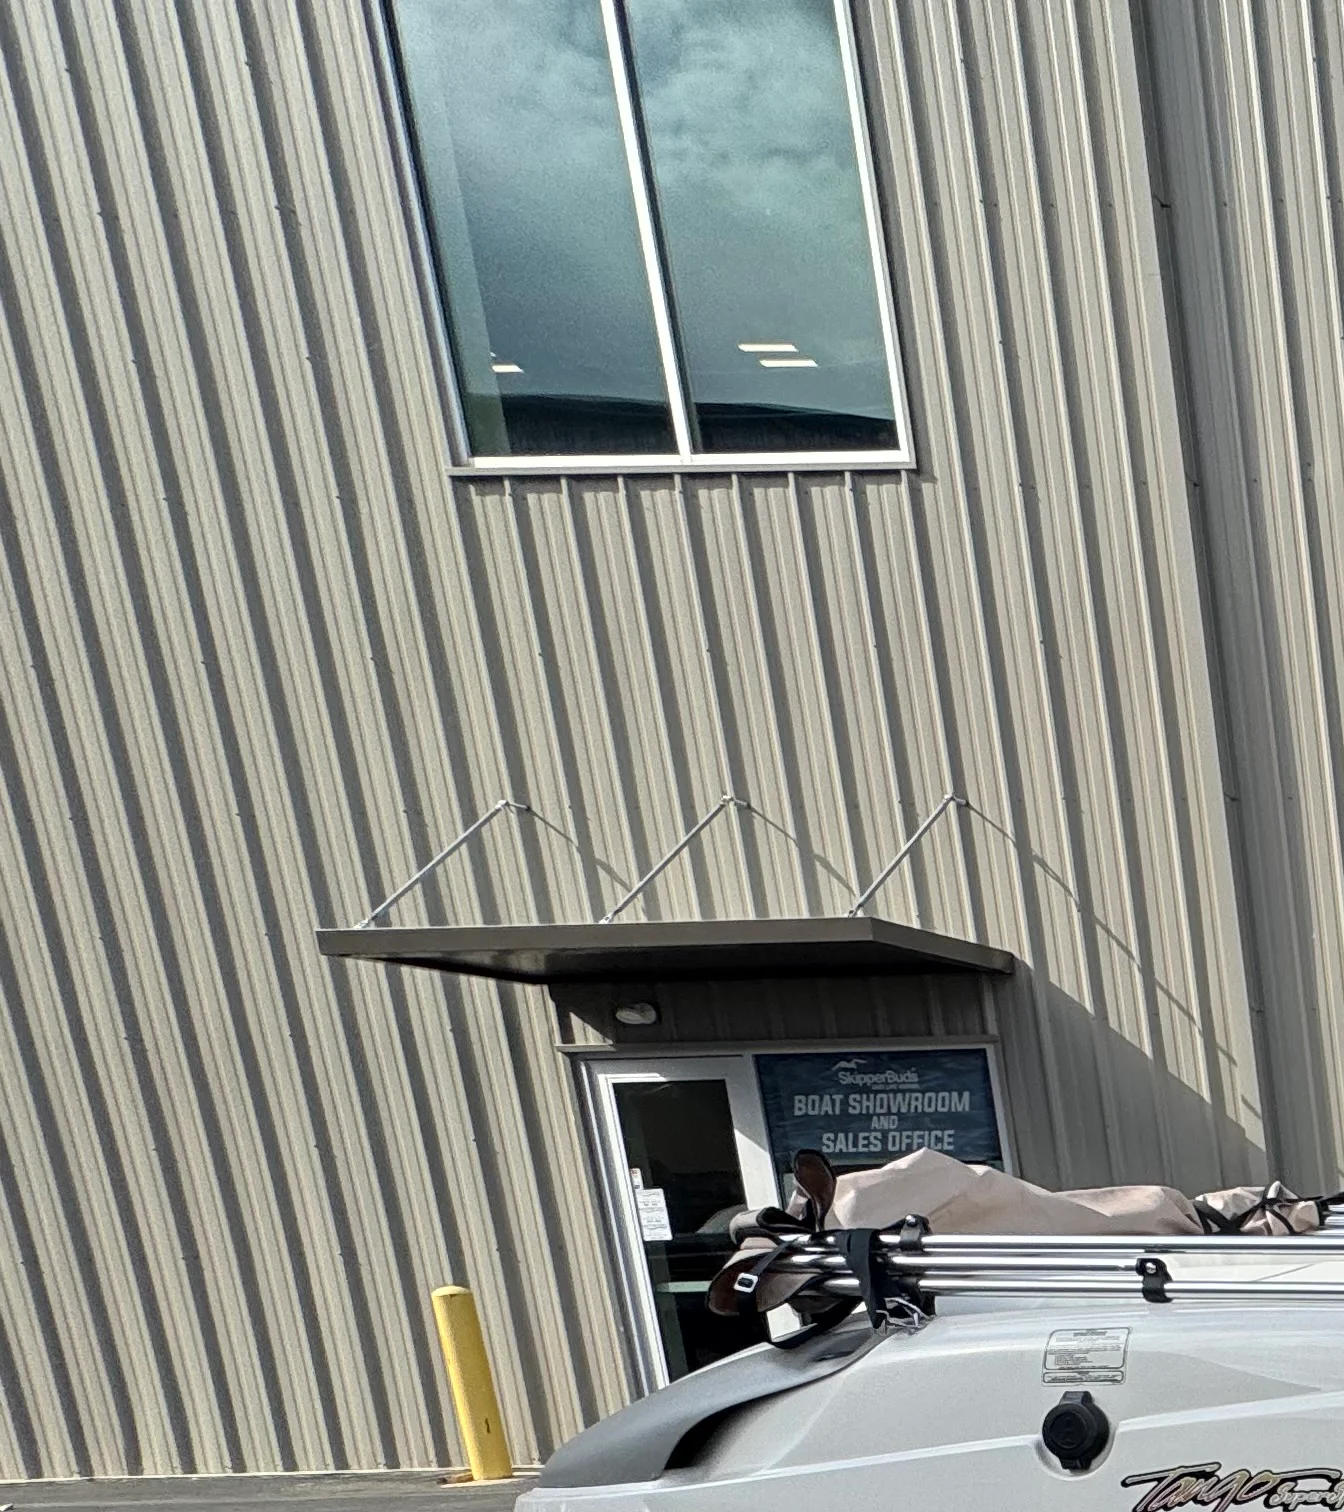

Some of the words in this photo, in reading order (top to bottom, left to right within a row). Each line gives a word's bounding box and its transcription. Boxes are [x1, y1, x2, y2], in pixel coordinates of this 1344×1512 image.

[793, 1094, 843, 1116] BOAT
[849, 1091, 971, 1115] SHOWROOM
[871, 1116, 899, 1130] AND
[822, 1132, 882, 1153] SALES
[888, 1130, 955, 1151] OFFICE
